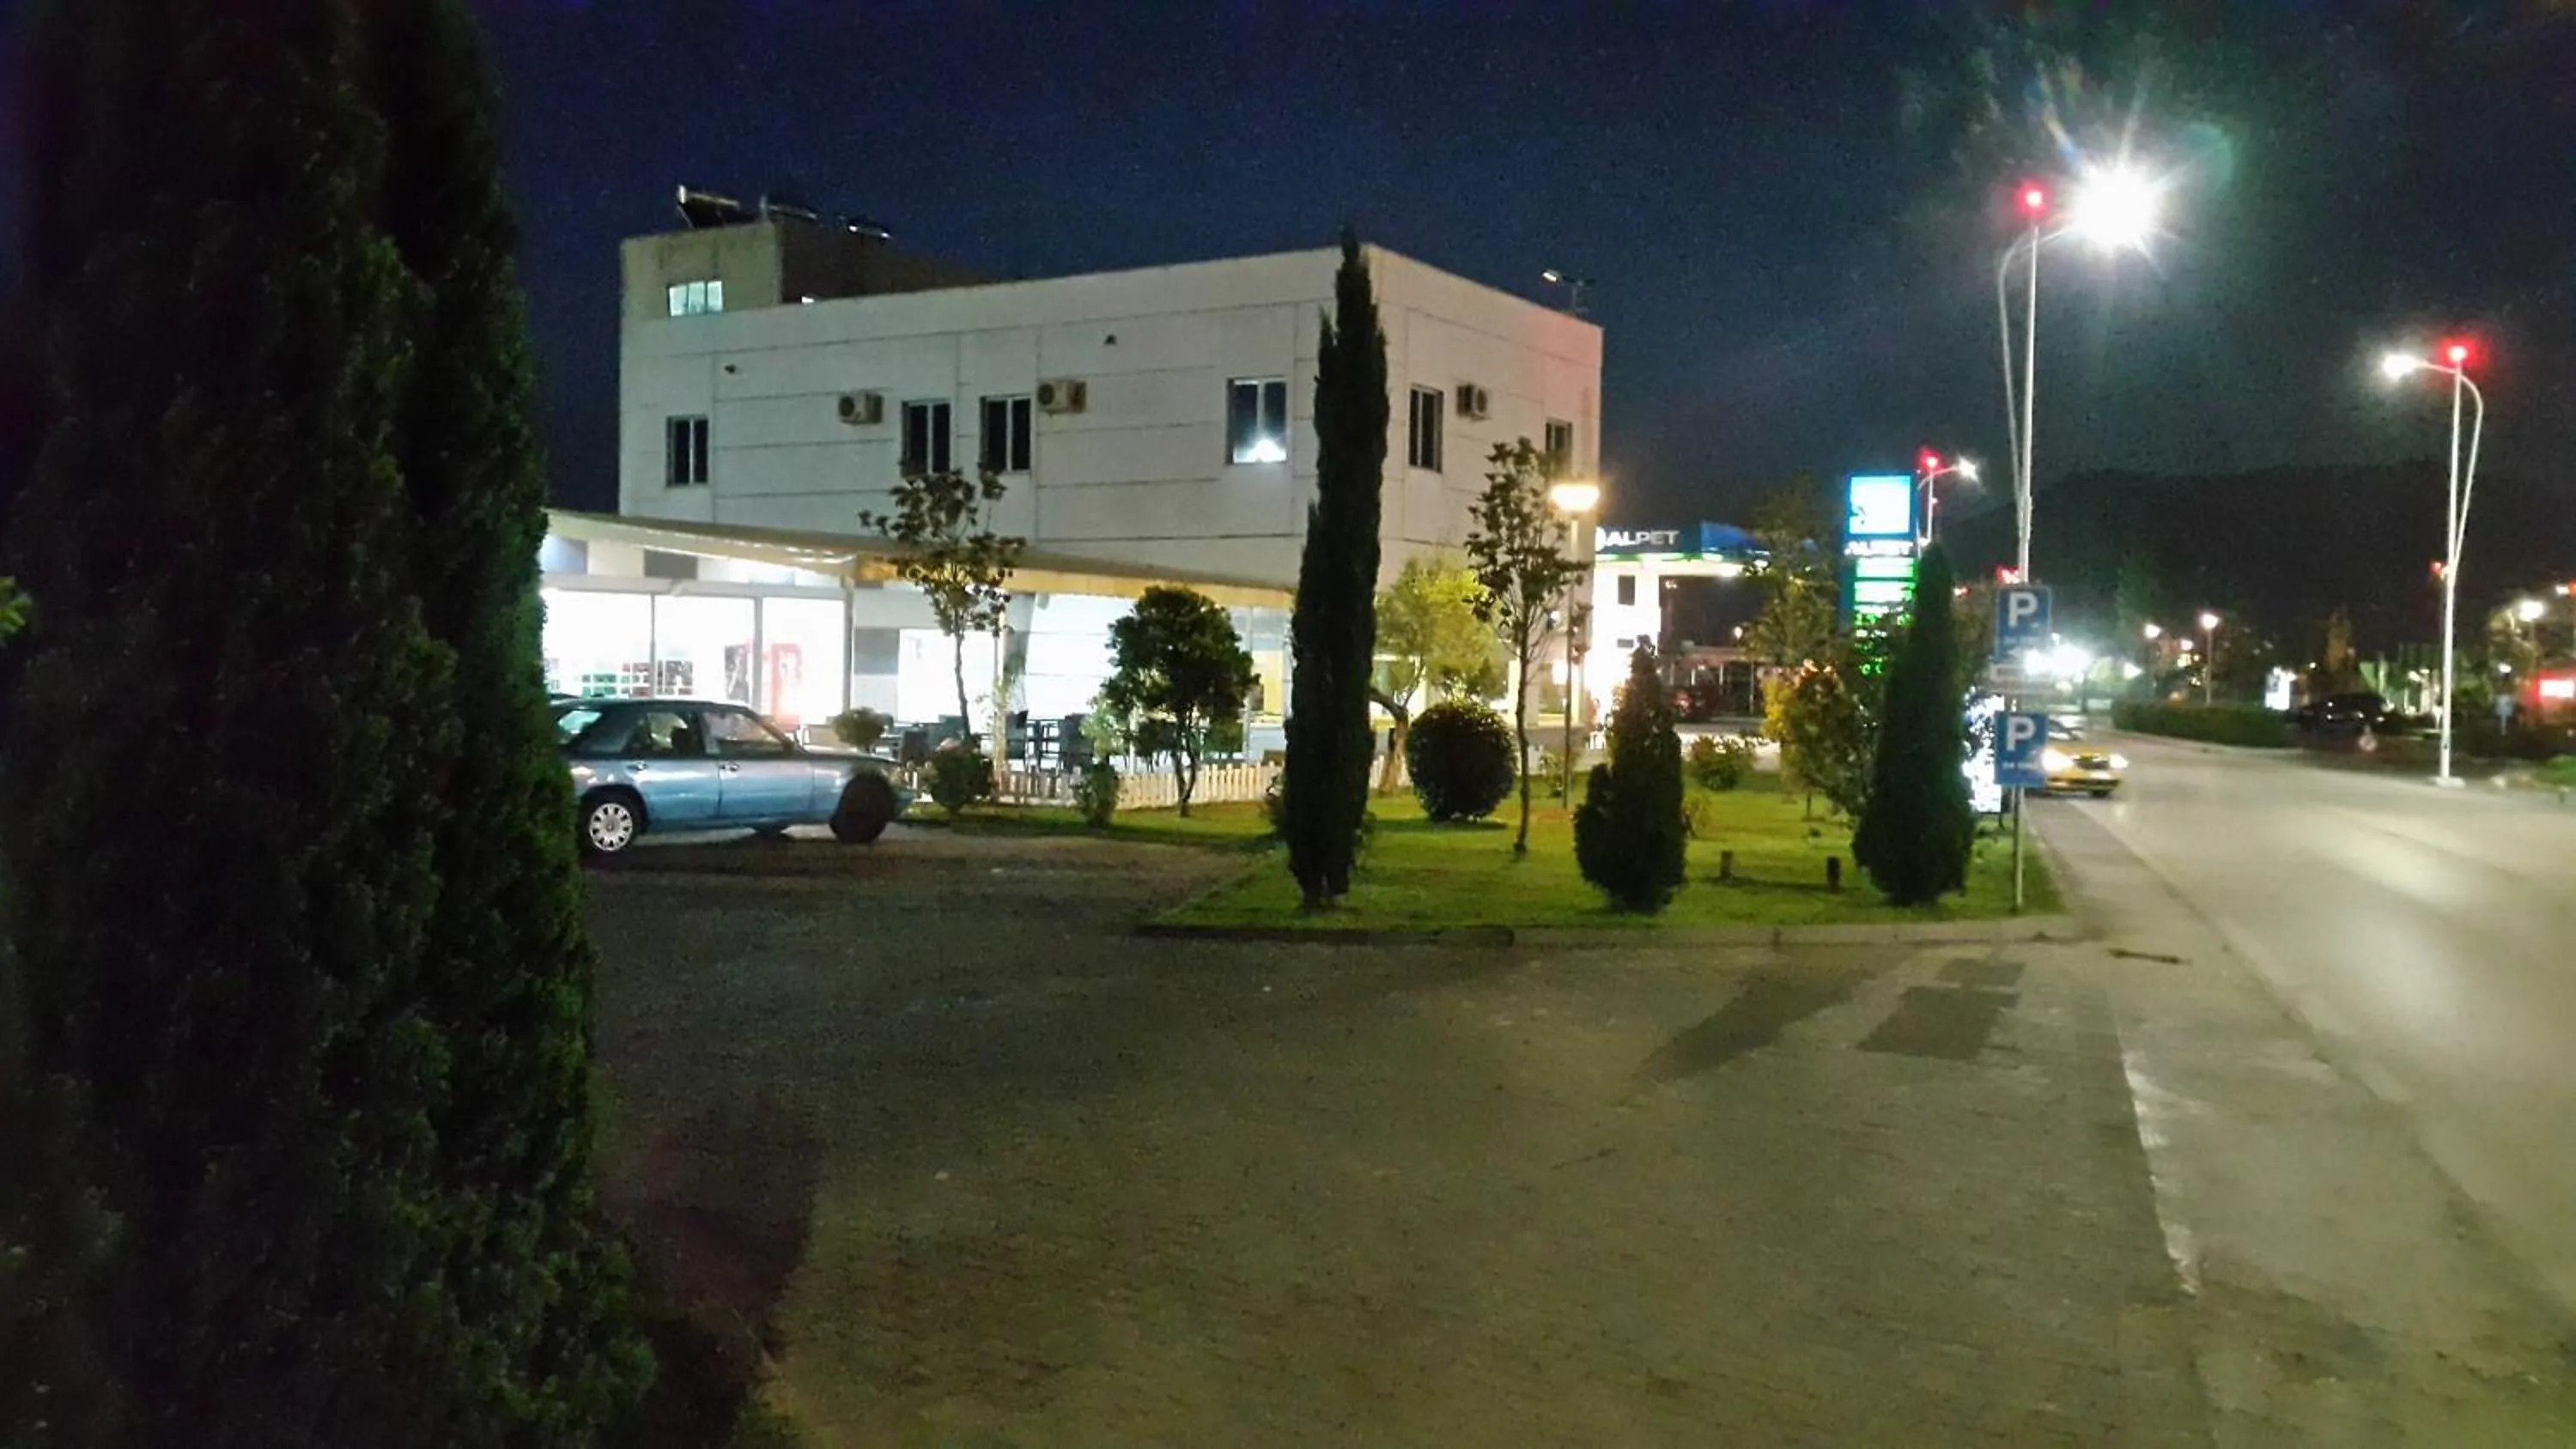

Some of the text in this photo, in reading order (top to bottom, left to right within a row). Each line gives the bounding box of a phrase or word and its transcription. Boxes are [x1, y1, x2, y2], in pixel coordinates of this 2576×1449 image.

[1607, 530, 1680, 547] ALPET
[2008, 591, 2038, 628] P
[2007, 716, 2036, 751] P
